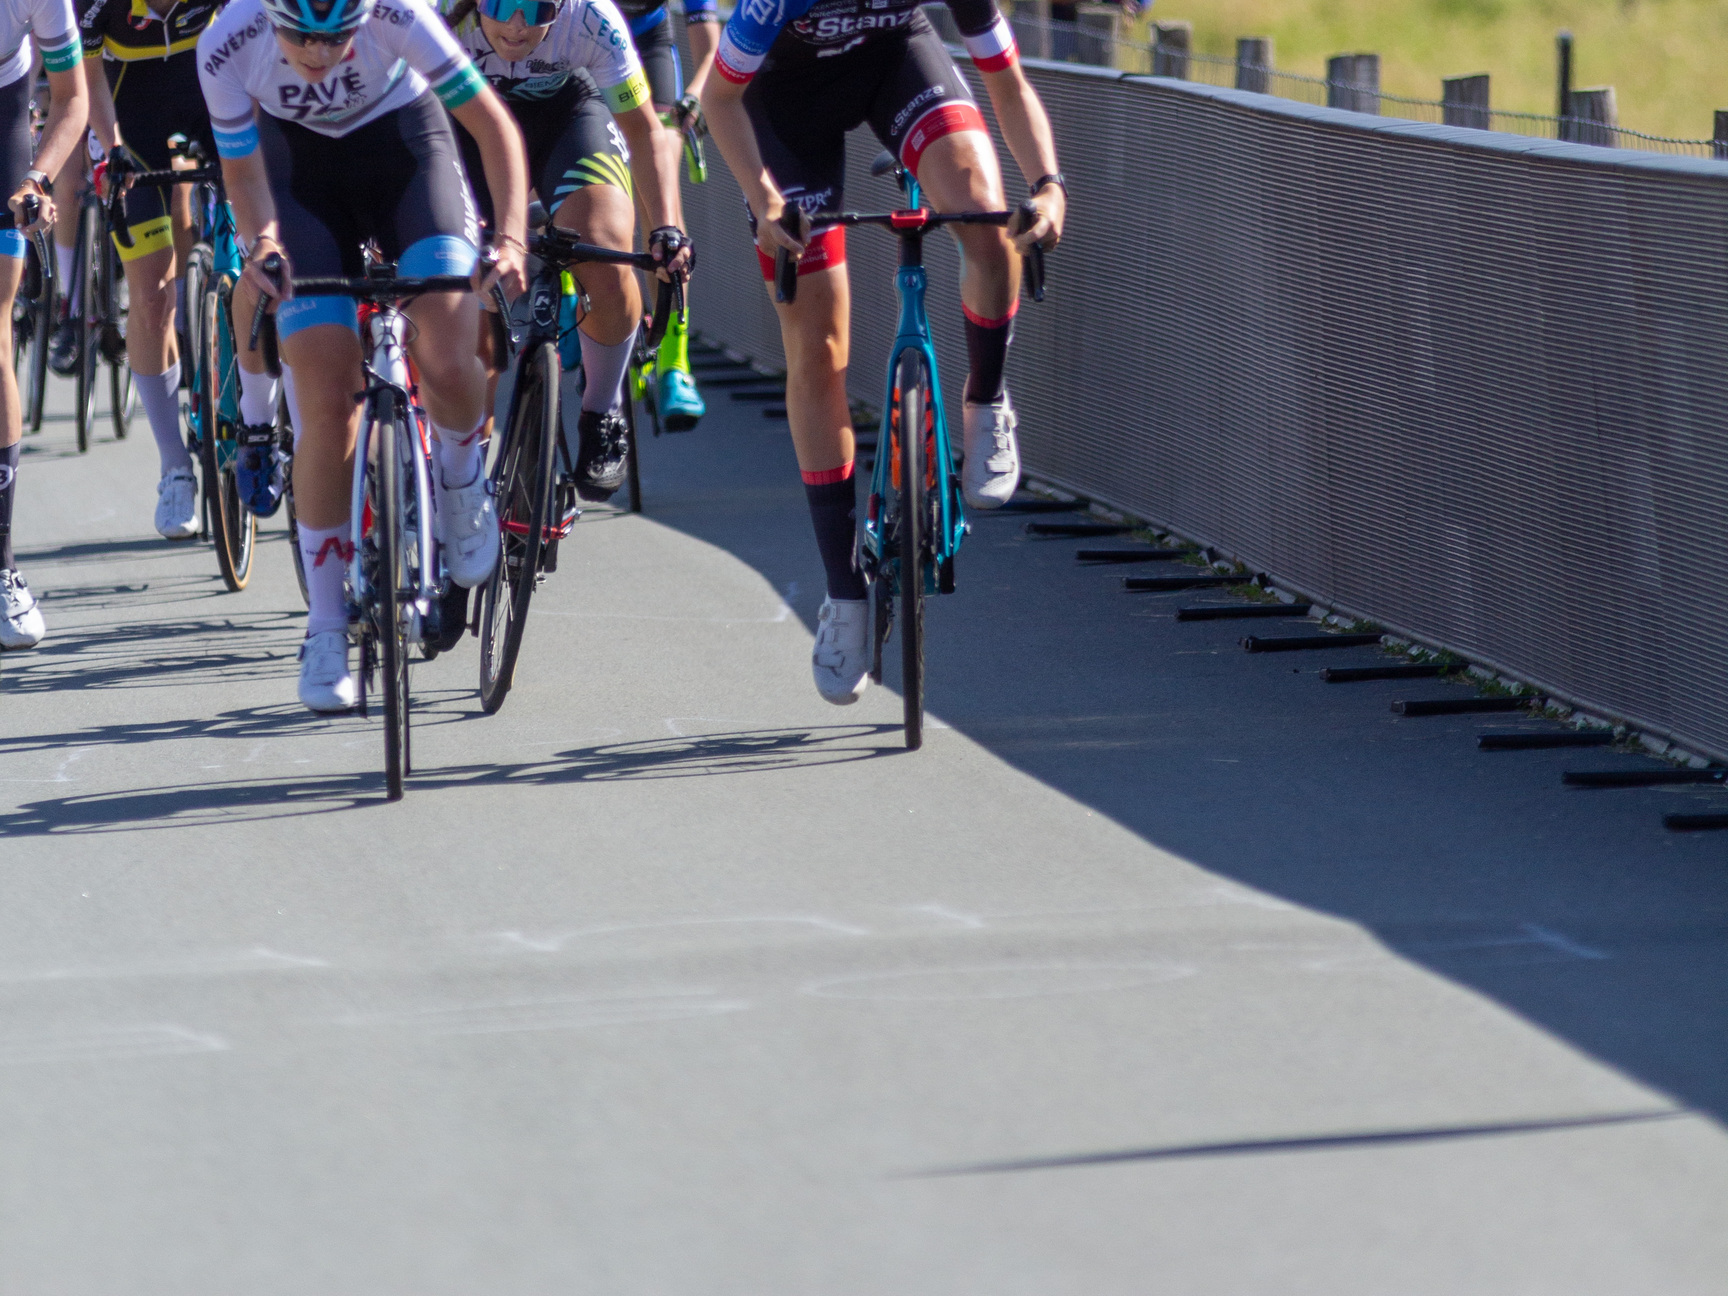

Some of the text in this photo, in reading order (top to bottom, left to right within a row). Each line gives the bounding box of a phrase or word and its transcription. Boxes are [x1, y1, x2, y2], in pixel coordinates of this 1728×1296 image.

[203, 25, 258, 77] PAVÉ76
[278, 66, 366, 106] PAVÉ
[894, 85, 945, 125] Stanza
